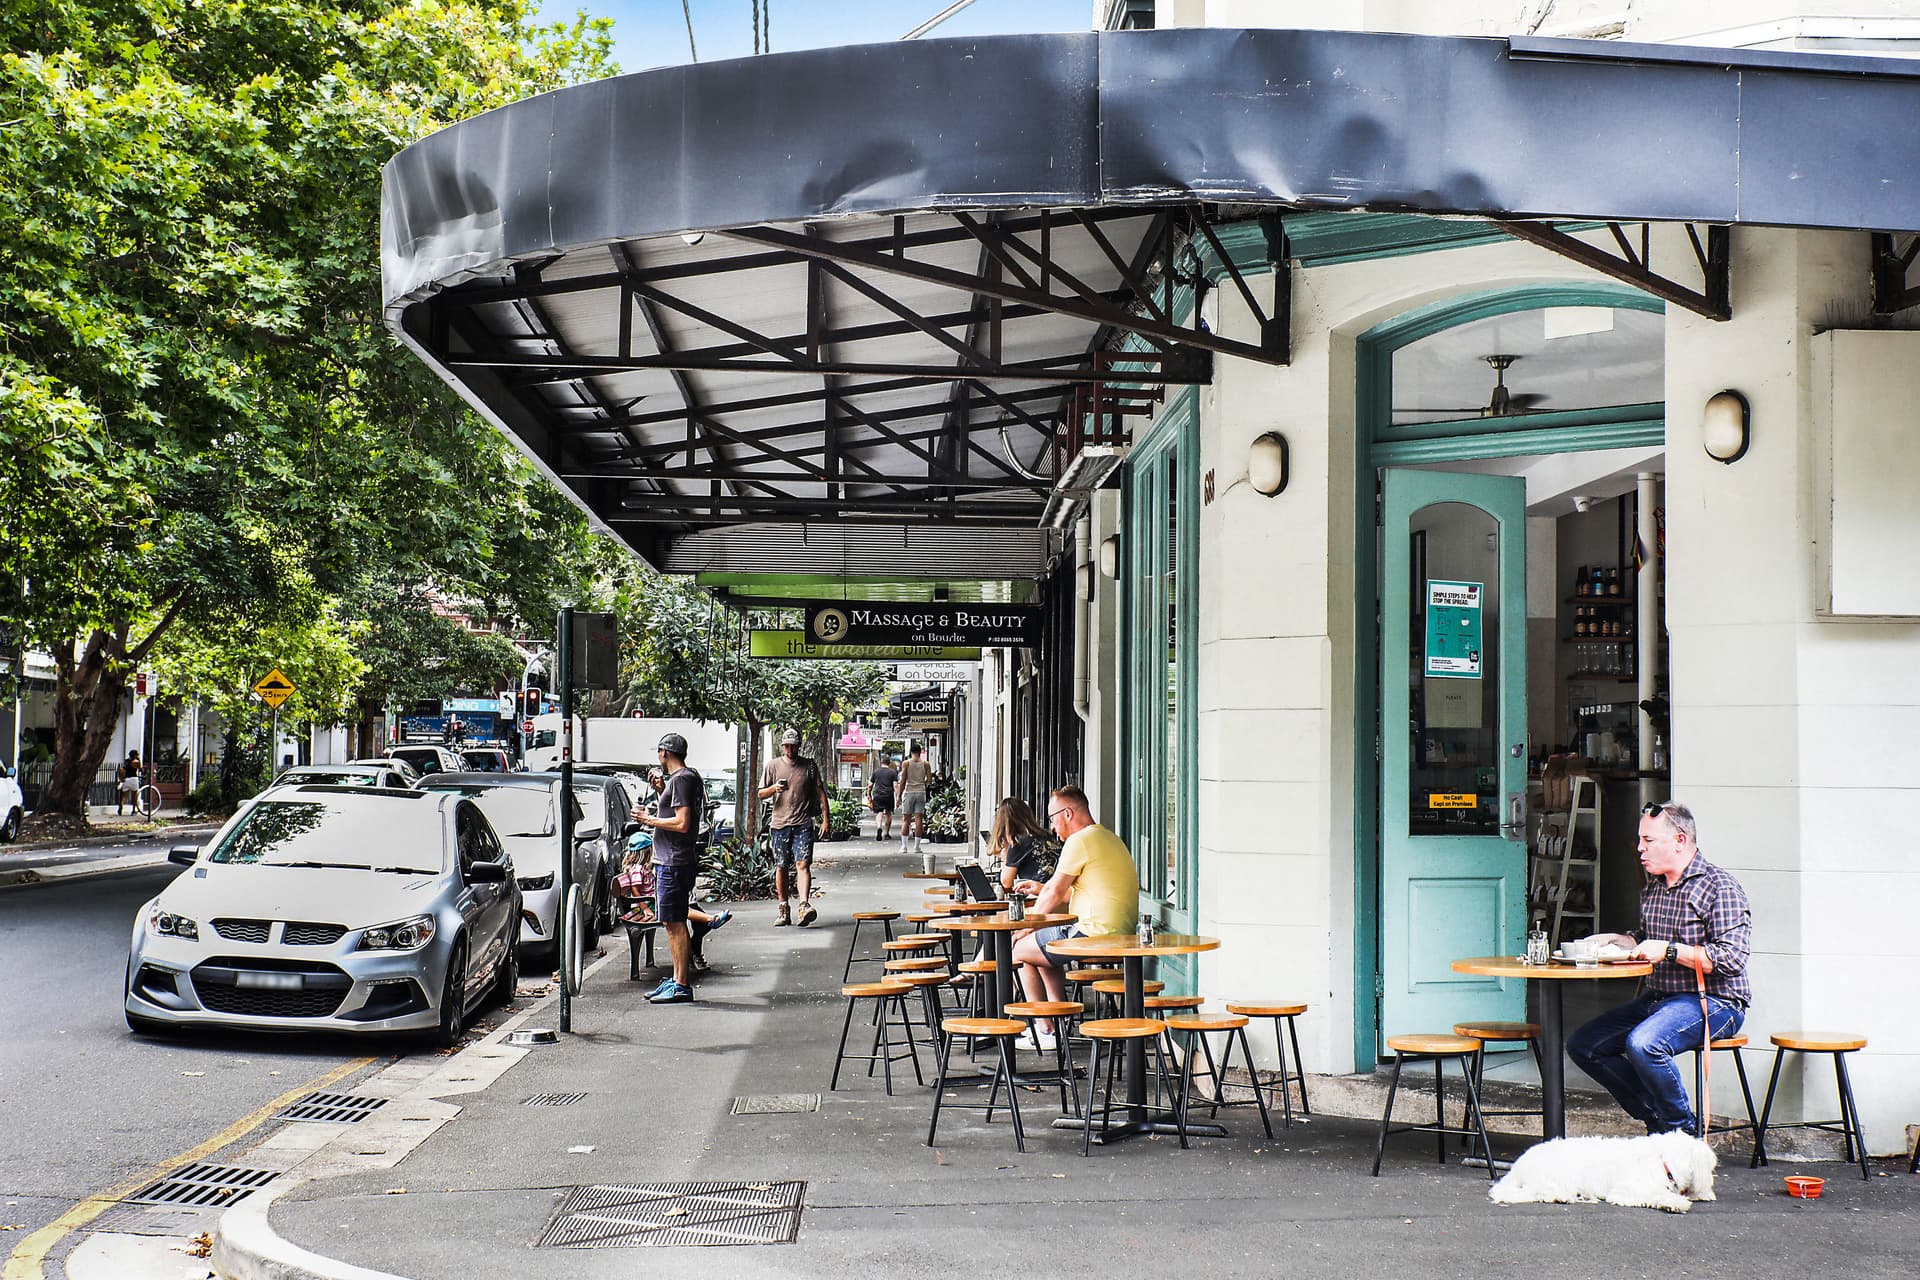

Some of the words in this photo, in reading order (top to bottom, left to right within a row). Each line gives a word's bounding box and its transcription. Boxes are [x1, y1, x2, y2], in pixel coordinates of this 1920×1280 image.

[851, 610, 934, 630] MASSAGE
[939, 615, 950, 627] &
[955, 612, 1027, 628] BEAUTY
[928, 632, 966, 643] Bourke
[787, 639, 816, 655] the
[905, 671, 920, 679] on
[924, 669, 966, 680] bourke
[903, 701, 947, 712] FLORIST
